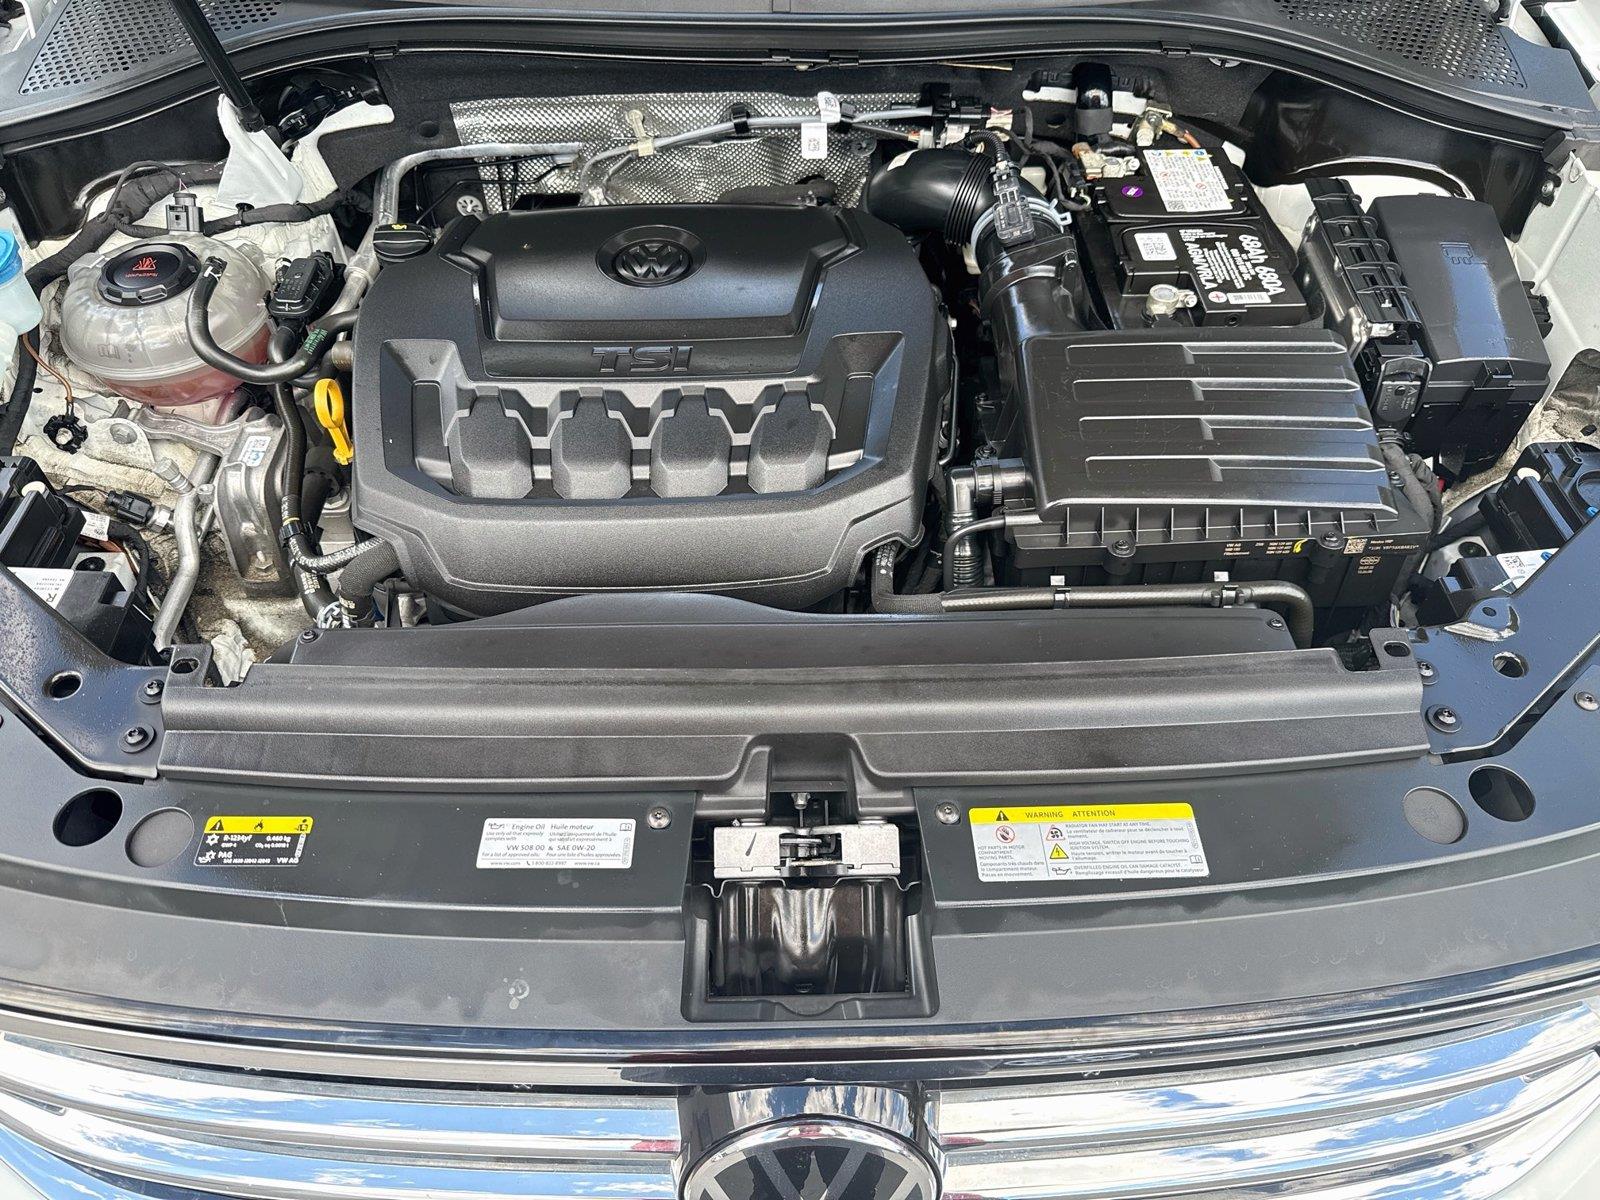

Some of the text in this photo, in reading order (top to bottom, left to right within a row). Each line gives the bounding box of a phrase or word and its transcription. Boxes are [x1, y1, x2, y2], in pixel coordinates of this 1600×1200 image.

[1239, 234, 1268, 264] 68Ah
[1255, 266, 1286, 296] 680A
[591, 345, 694, 374] TSI
[46, 593, 57, 603] R
[1025, 811, 1063, 819] WARNING
[223, 834, 252, 843] R-1234yf
[283, 835, 291, 843] kg
[218, 851, 233, 859] PAG
